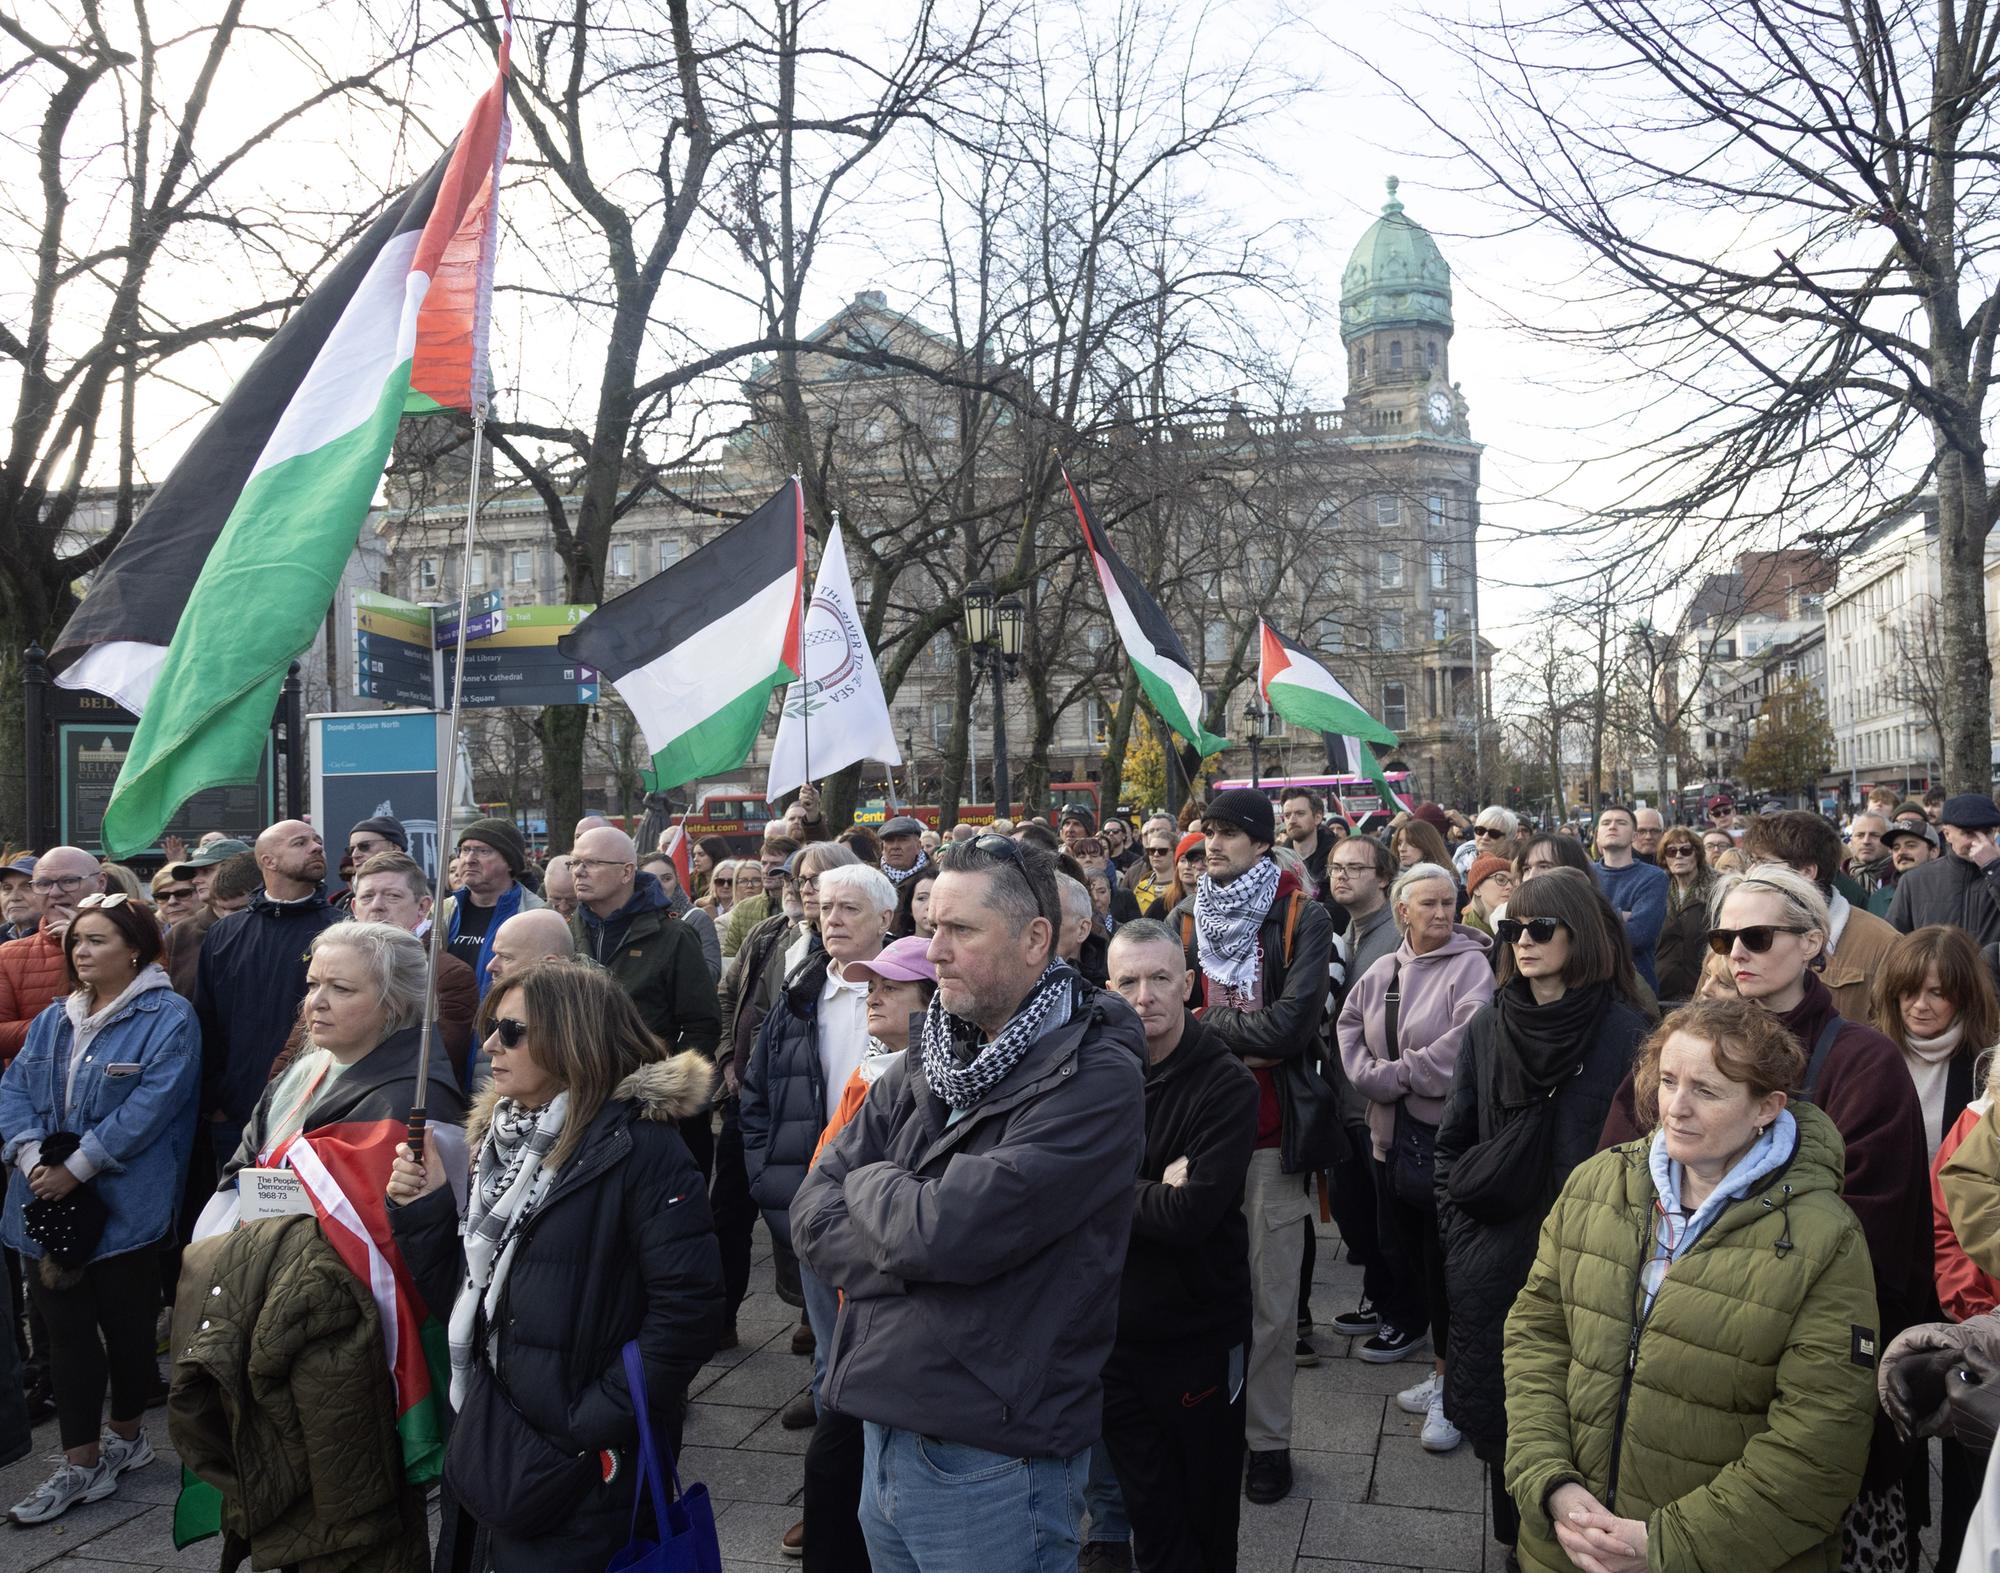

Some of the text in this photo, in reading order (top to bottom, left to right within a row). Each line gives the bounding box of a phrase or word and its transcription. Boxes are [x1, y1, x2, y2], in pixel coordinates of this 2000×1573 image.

[450, 653, 501, 663] Ctral Library
[462, 674, 486, 682] Anne's
[489, 672, 523, 681] Cathedral
[470, 694, 495, 703] Square
[829, 684, 855, 703] SEA
[327, 720, 400, 732] Donegall Square North
[80, 762, 119, 773] BELFA
[854, 811, 886, 824] Centr
[257, 1183, 299, 1192] Democracy
